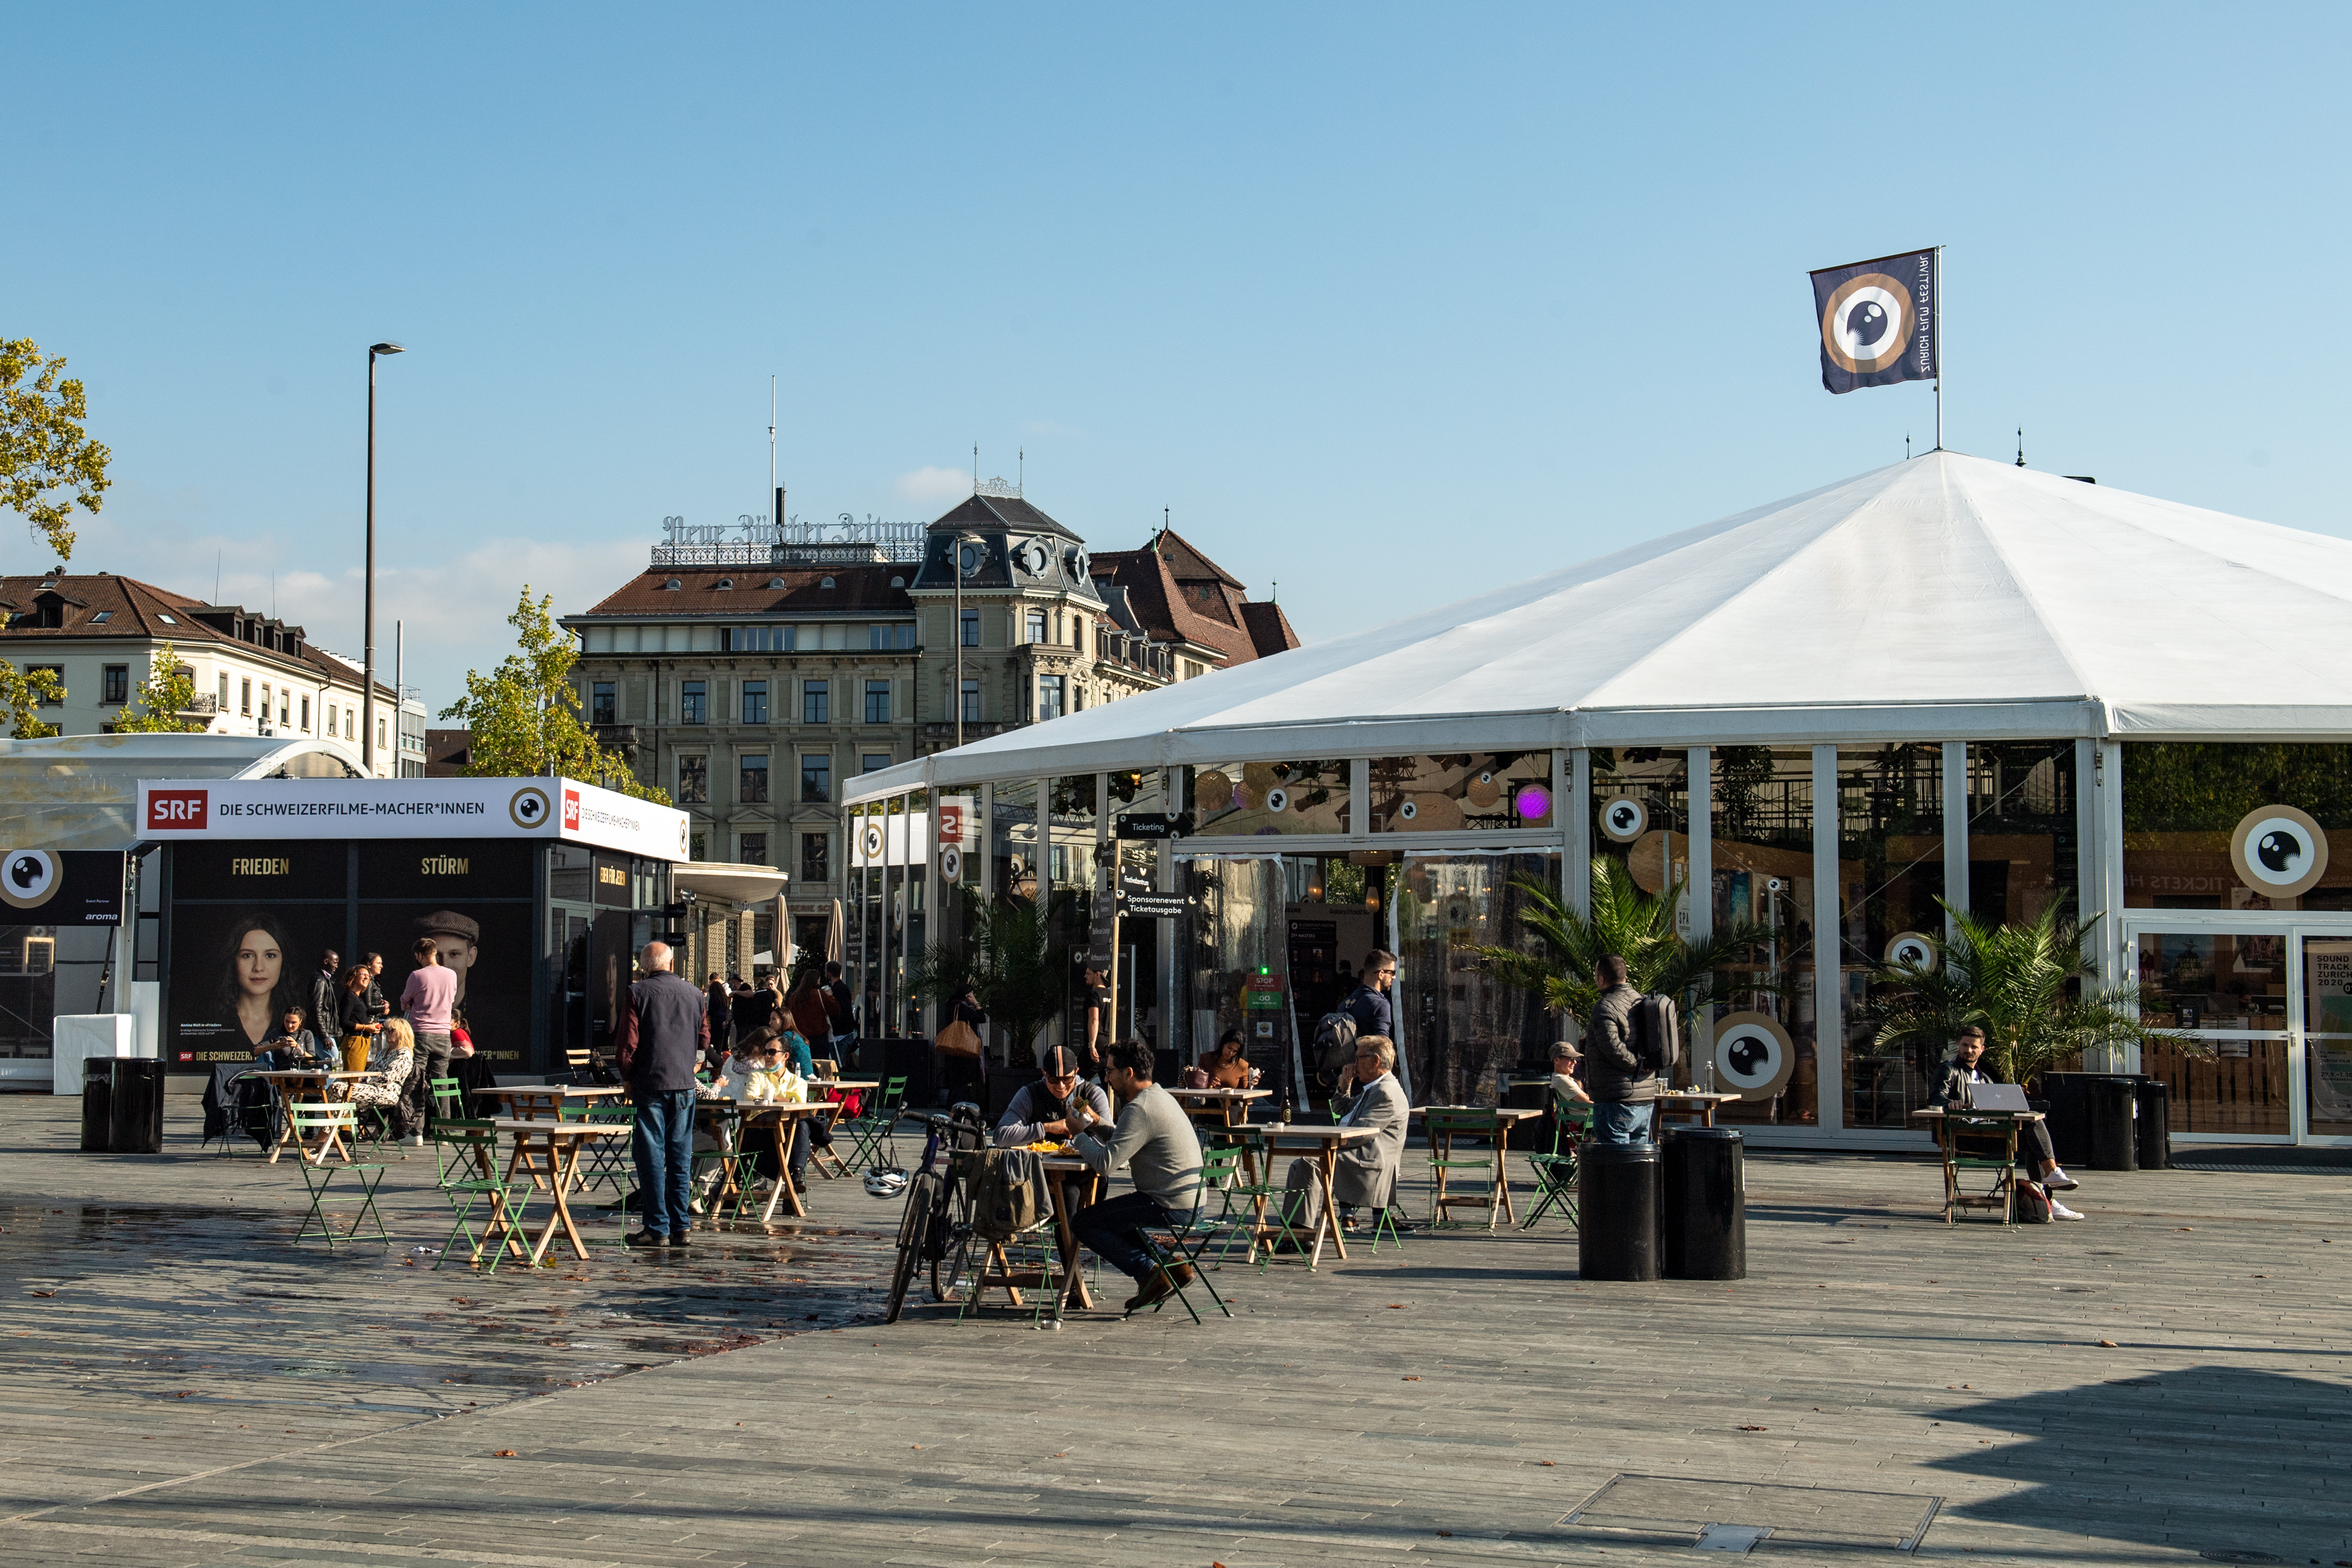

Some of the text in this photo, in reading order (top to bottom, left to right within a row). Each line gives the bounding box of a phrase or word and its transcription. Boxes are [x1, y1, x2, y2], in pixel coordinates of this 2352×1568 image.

[661, 513, 928, 548] Neue Zürcher Zeitung
[154, 799, 201, 820] SRF
[220, 804, 243, 816] DIE
[566, 799, 579, 821] SRF
[1133, 823, 1164, 832] Ticketing
[232, 858, 289, 875] FRIEDEN
[421, 854, 469, 875] STÜRM
[600, 866, 609, 884] EDEN
[615, 869, 626, 886] JEDEN
[1124, 875, 1149, 886] Festivalzentrum
[1127, 895, 1185, 905] Sponsorenevent
[1130, 905, 1182, 915] Ticketausgabe
[196, 1052, 208, 1061] DIE
